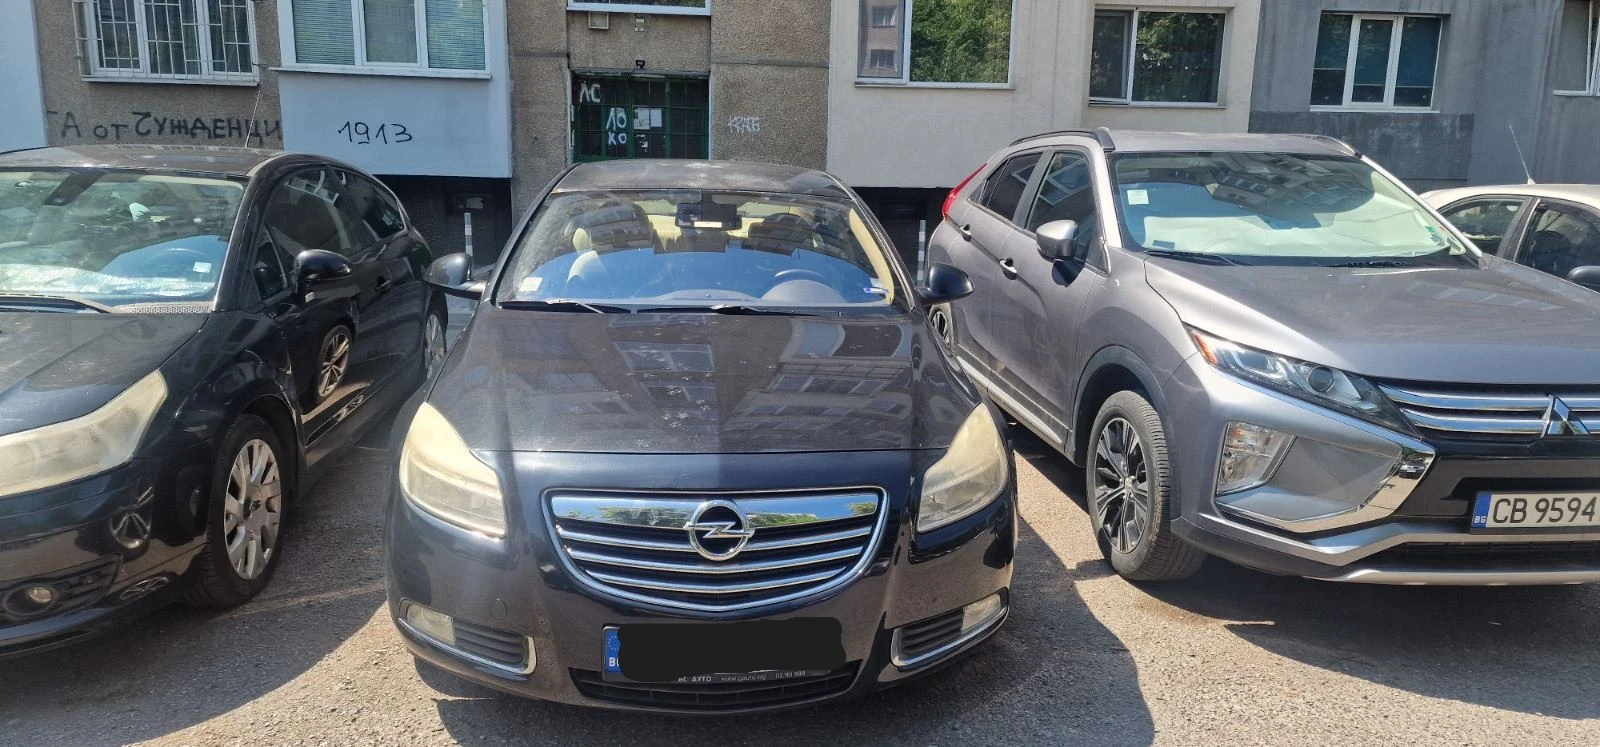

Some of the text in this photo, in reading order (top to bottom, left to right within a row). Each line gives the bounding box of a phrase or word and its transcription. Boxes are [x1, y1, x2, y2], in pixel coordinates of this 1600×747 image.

[338, 121, 413, 145] 1913
[1492, 496, 1598, 524] CB 9594
[1474, 515, 1487, 524] BG
[608, 656, 620, 668] B
